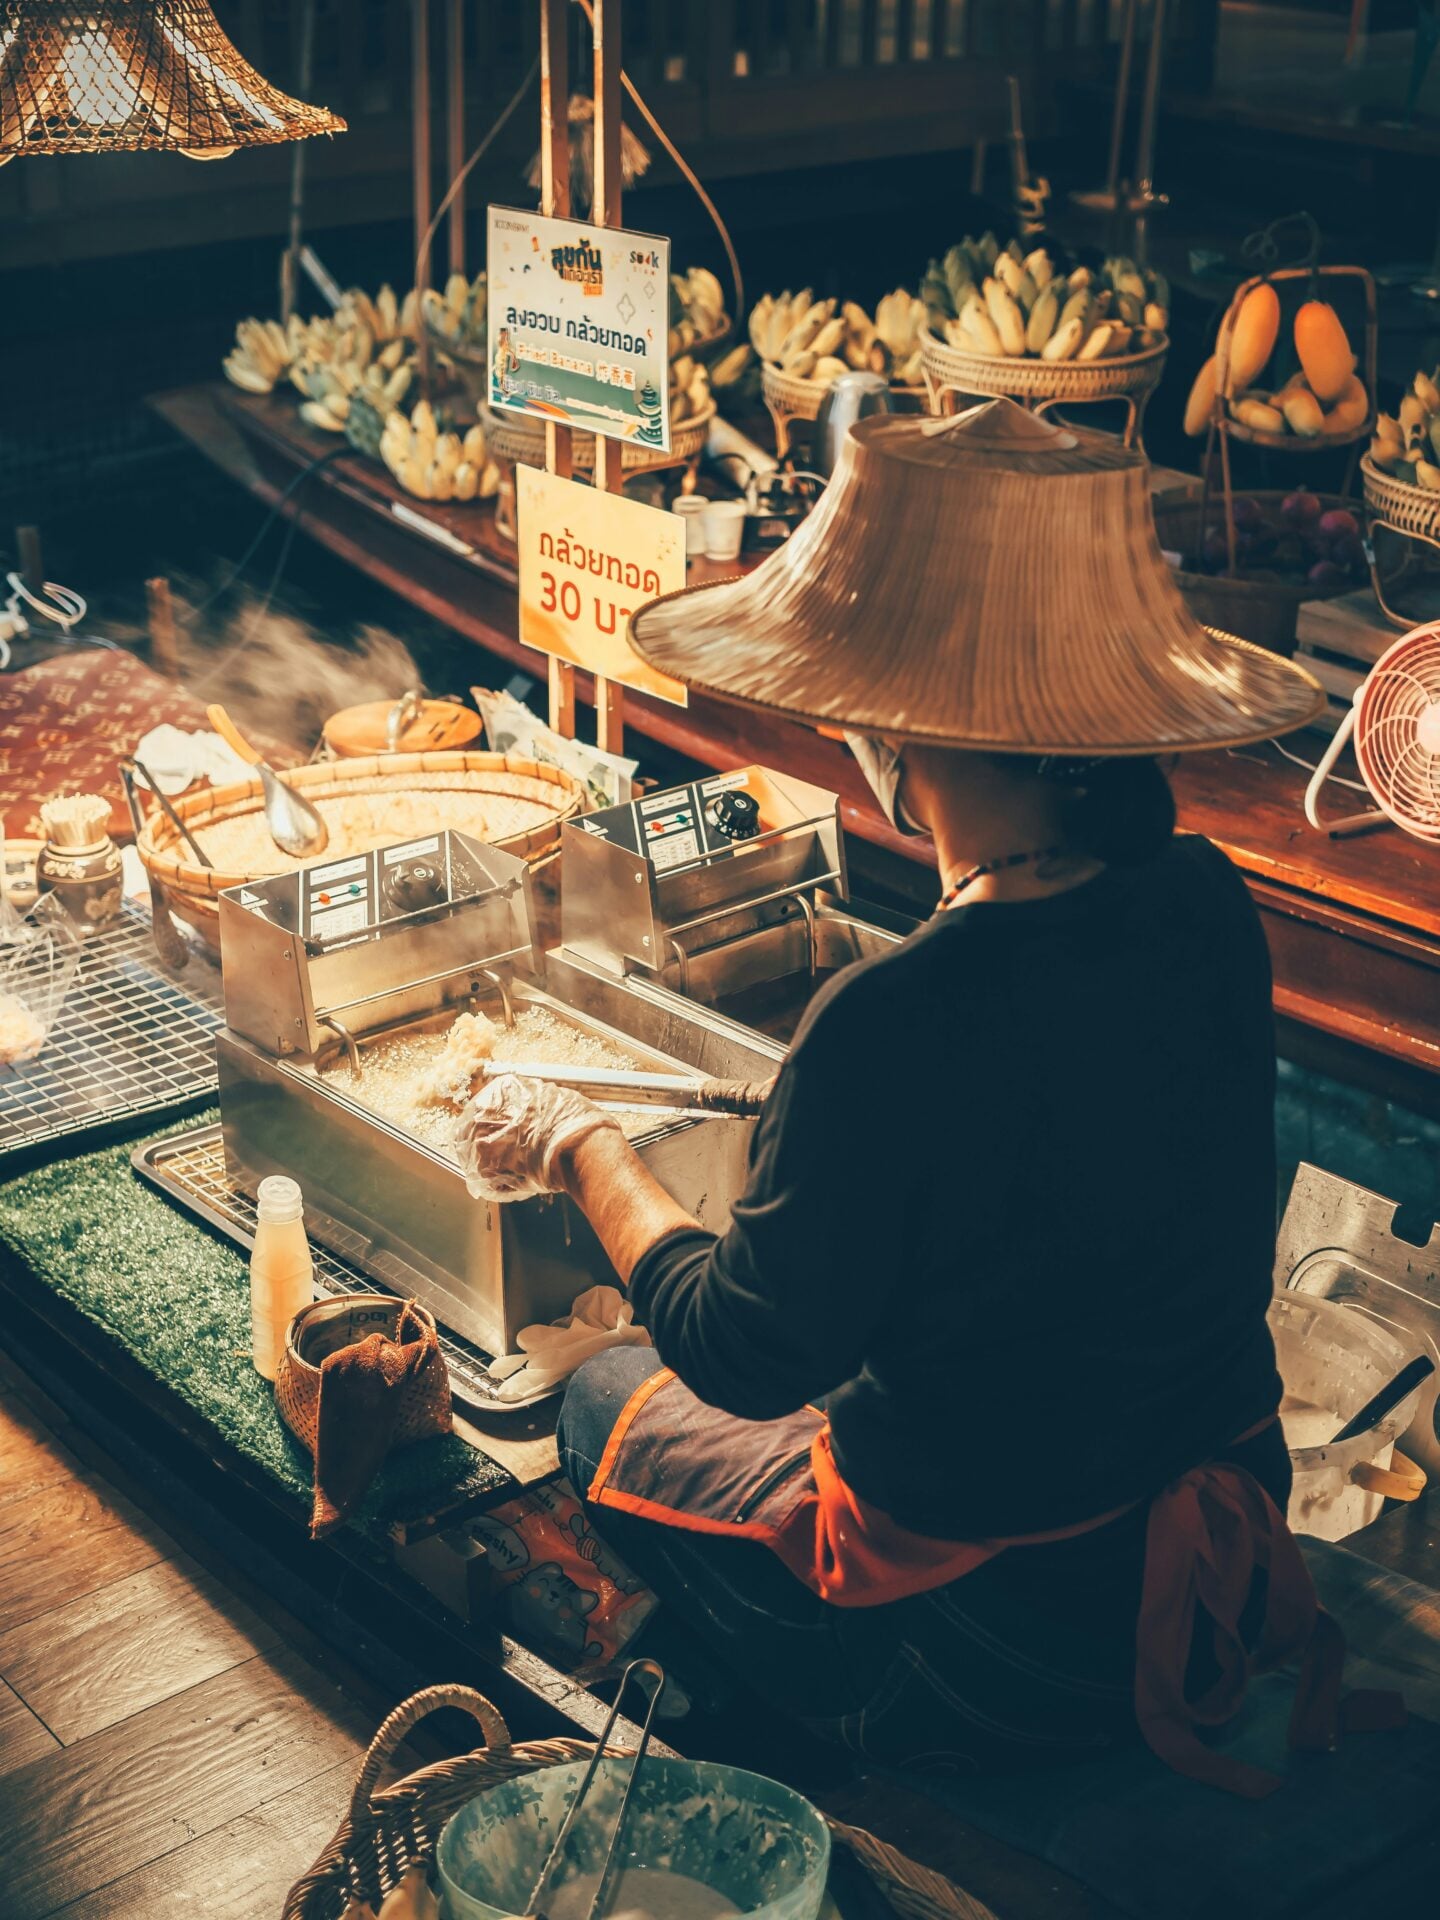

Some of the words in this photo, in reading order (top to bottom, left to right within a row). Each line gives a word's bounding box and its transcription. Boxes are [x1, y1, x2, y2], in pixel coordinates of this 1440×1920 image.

[506, 306, 560, 333] ลุงจวบ
[566, 315, 646, 356] กล้วยทอด
[550, 351, 593, 376] Banana
[540, 528, 661, 596] กล้วยทอด
[541, 571, 581, 621] 30
